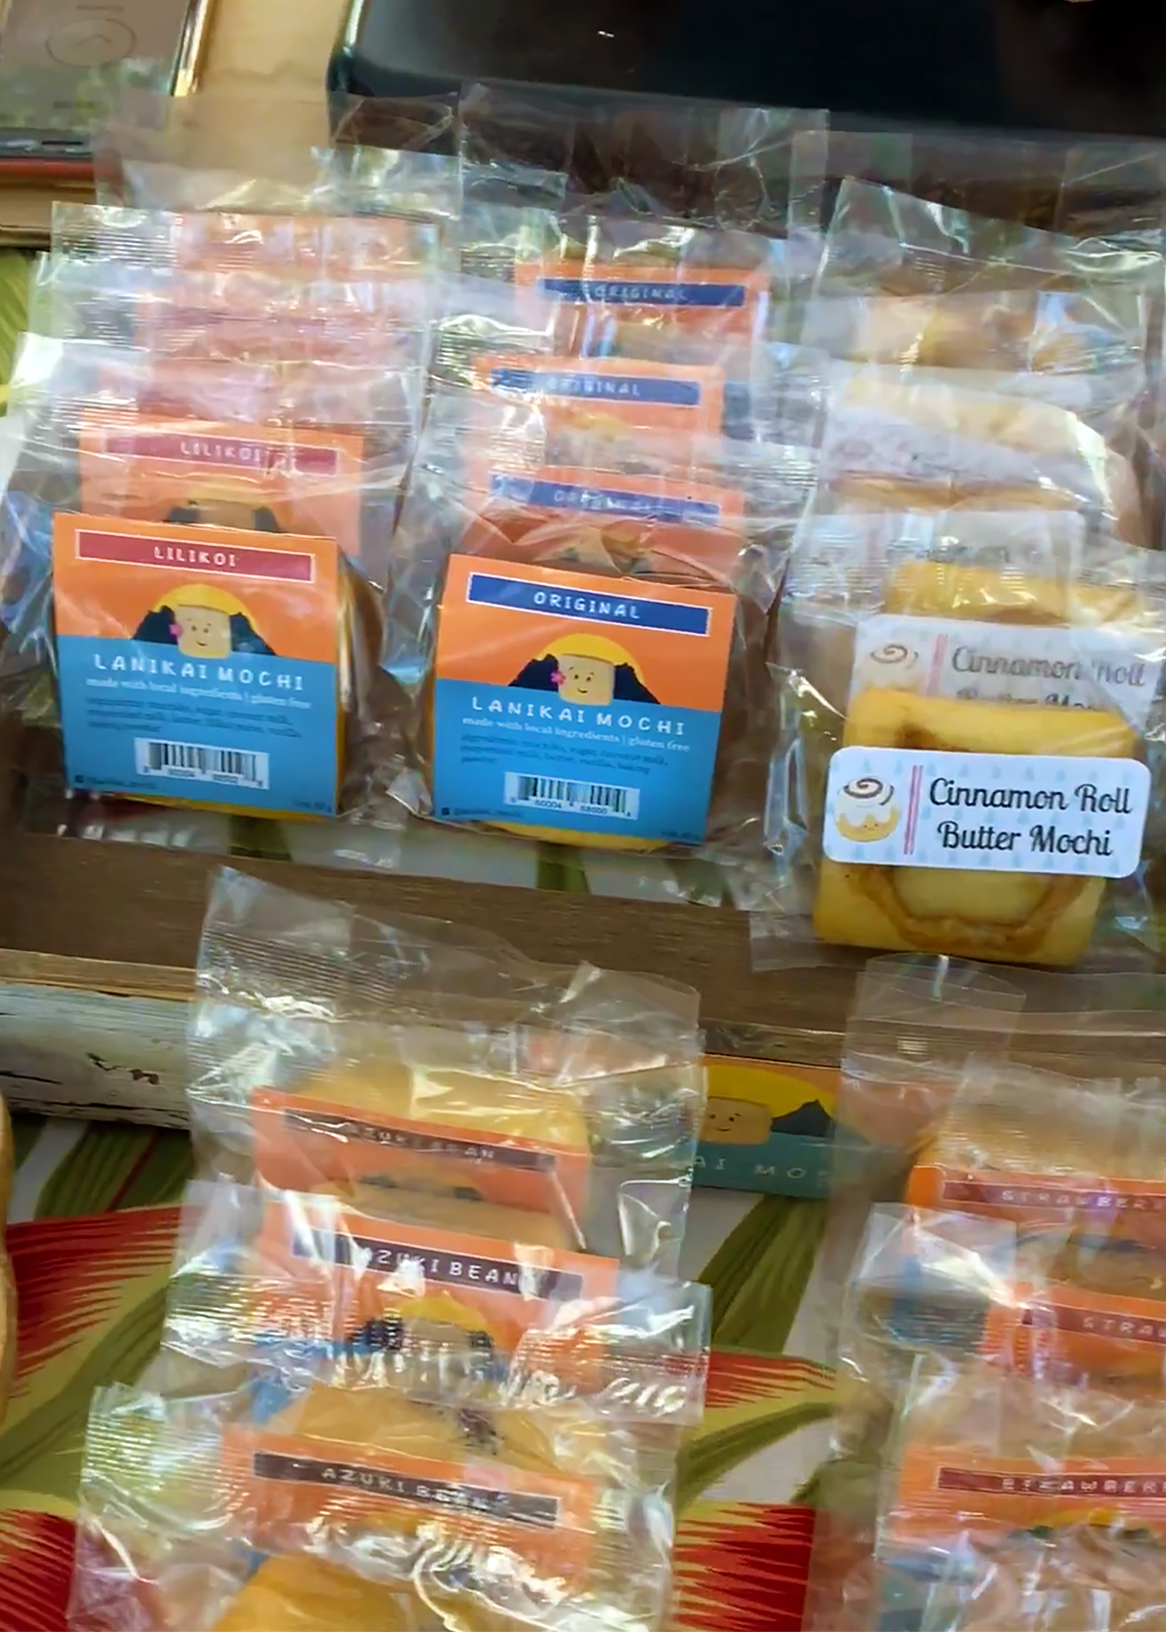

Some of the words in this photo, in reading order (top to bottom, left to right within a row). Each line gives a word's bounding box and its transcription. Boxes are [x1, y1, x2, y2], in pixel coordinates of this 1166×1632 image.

[153, 545, 236, 567] LILIKOI
[533, 591, 640, 619] ORIGINAL
[94, 653, 208, 679] LANIKAI
[217, 666, 304, 691] MOCHI
[951, 645, 1079, 680] Cinnamon
[472, 696, 585, 723] LANIKAI
[596, 712, 685, 736] MOCHI
[929, 777, 1069, 811] Cinnamon
[1074, 783, 1133, 814] Roll
[936, 820, 1022, 850] Butter
[1029, 824, 1114, 857] Mochi
[449, 1261, 518, 1286] BEAN
[321, 1467, 406, 1494] AZUKI
